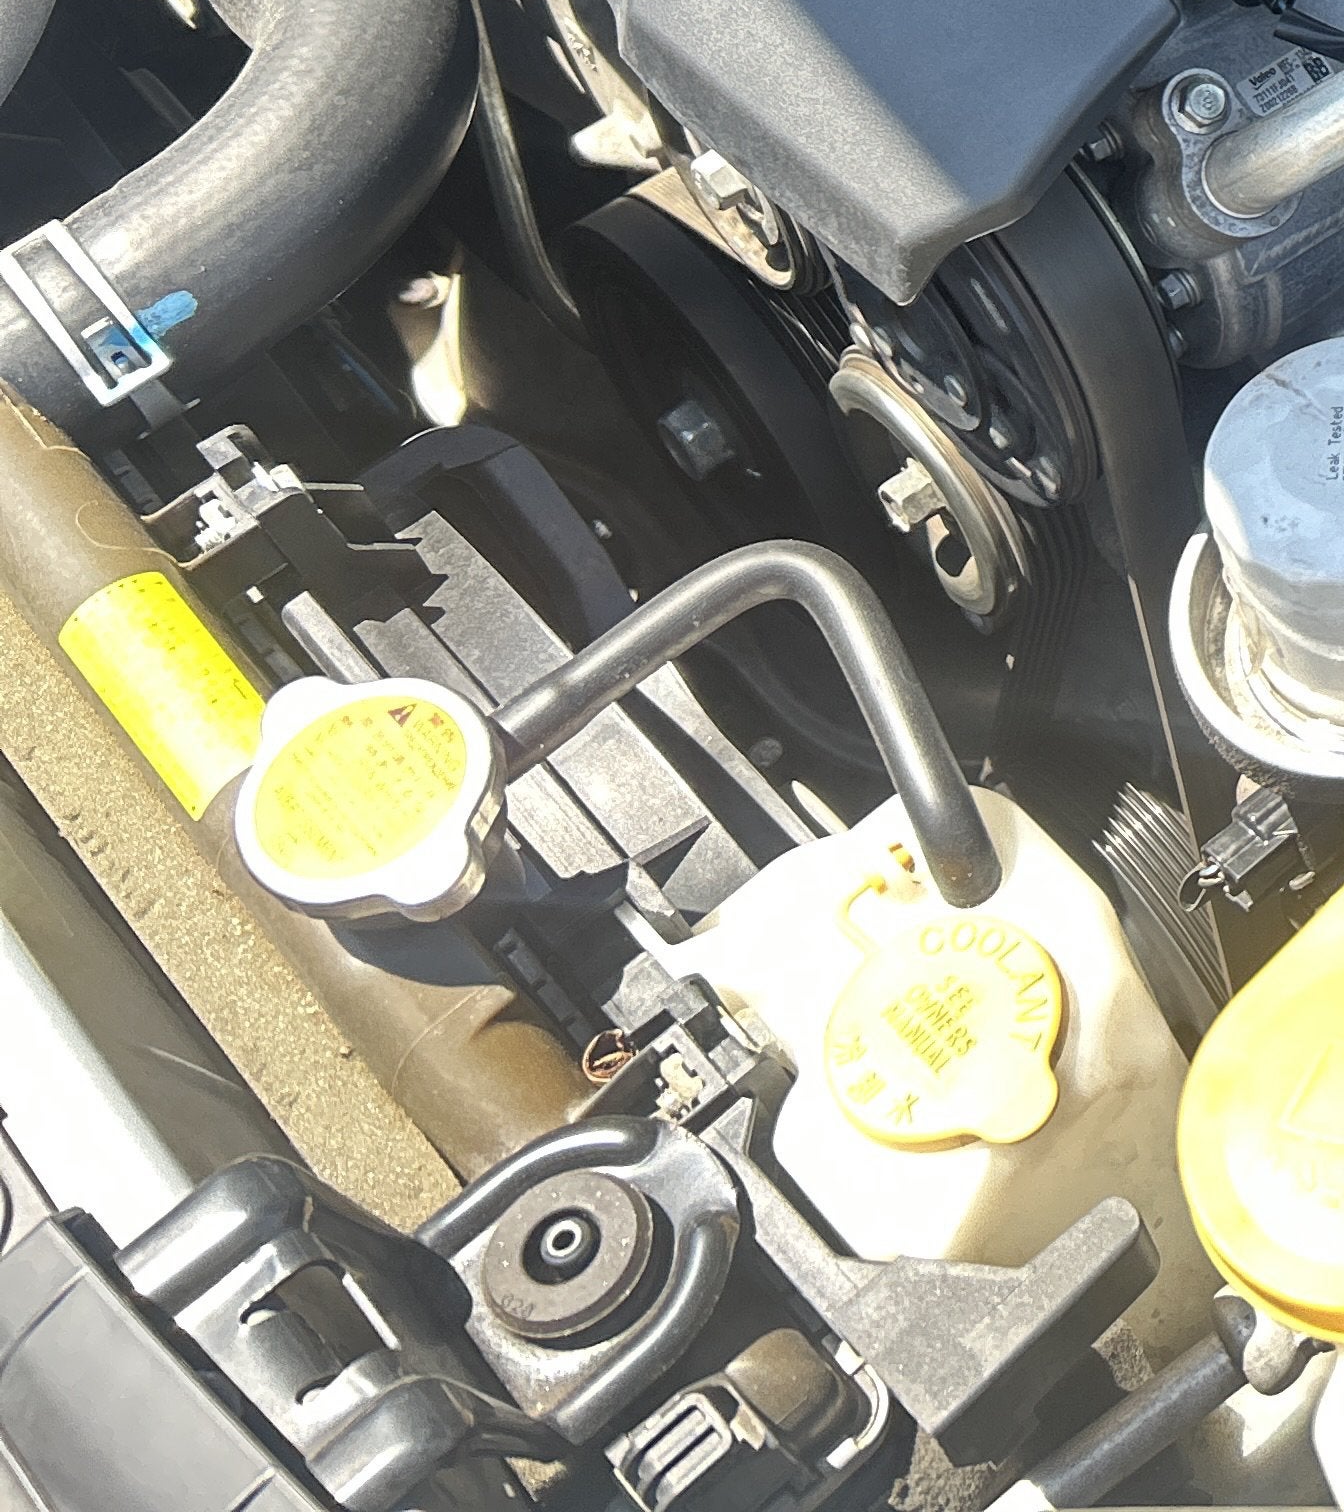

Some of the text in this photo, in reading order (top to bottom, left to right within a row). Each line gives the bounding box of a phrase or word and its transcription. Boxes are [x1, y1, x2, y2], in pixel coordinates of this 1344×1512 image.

[1326, 406, 1344, 481] Leak Tested
[918, 921, 1048, 1052] COOLANT
[935, 975, 976, 1019] SEE
[880, 1002, 951, 1076] MANUAL
